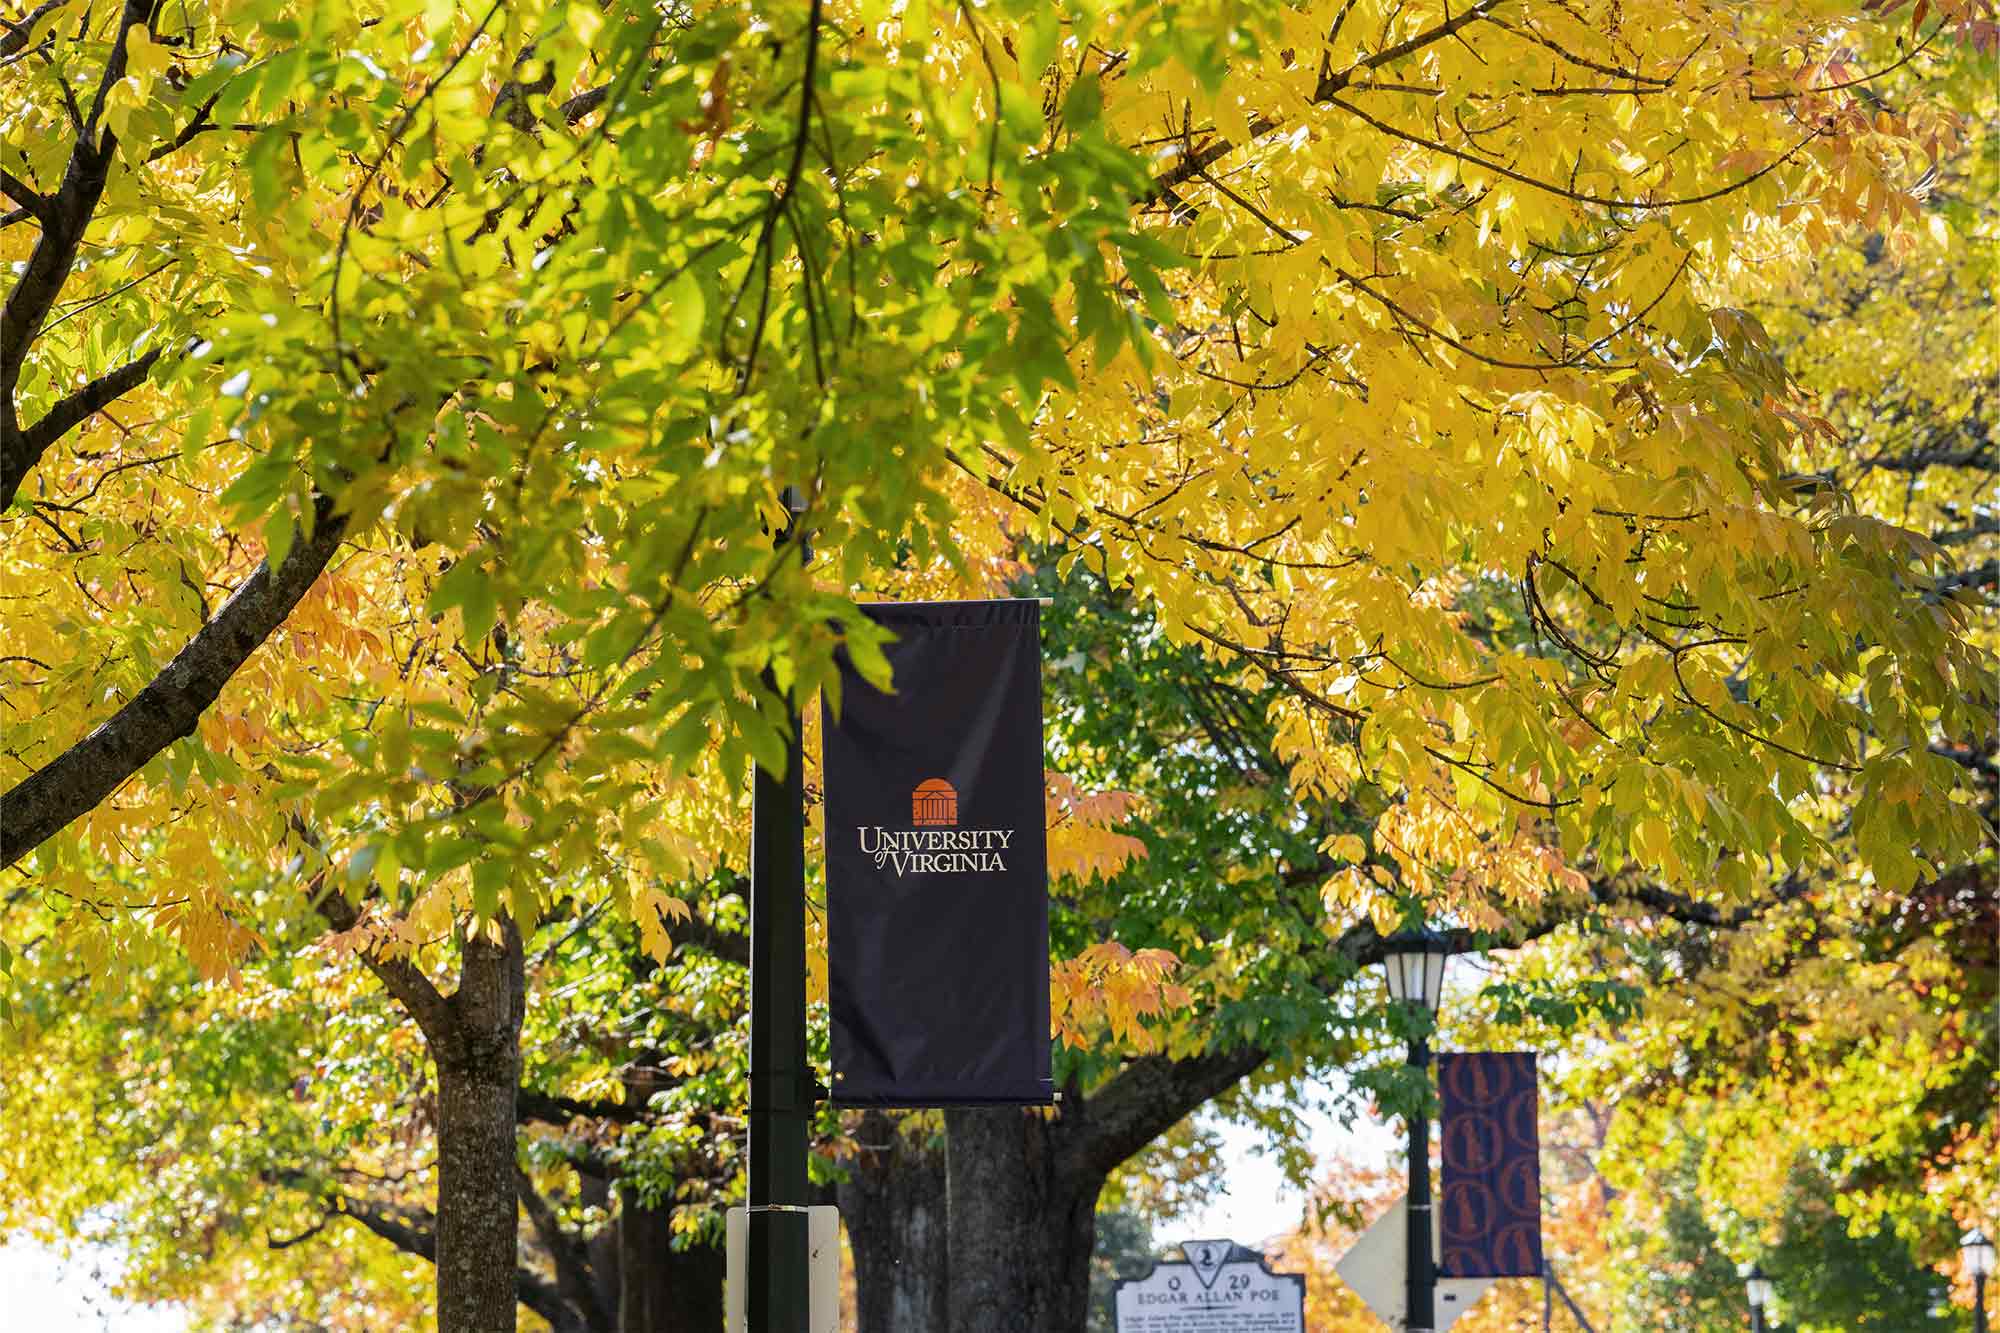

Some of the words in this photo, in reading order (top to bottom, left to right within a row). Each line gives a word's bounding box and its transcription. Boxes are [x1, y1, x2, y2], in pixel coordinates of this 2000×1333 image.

[874, 844, 899, 869] of
[888, 850, 1008, 878] VIRGINIA
[1229, 1274, 1250, 1289] 29
[1137, 1292, 1188, 1305] EDGAR
[1196, 1291, 1242, 1303] ALLAN
[1250, 1289, 1280, 1302] POE
